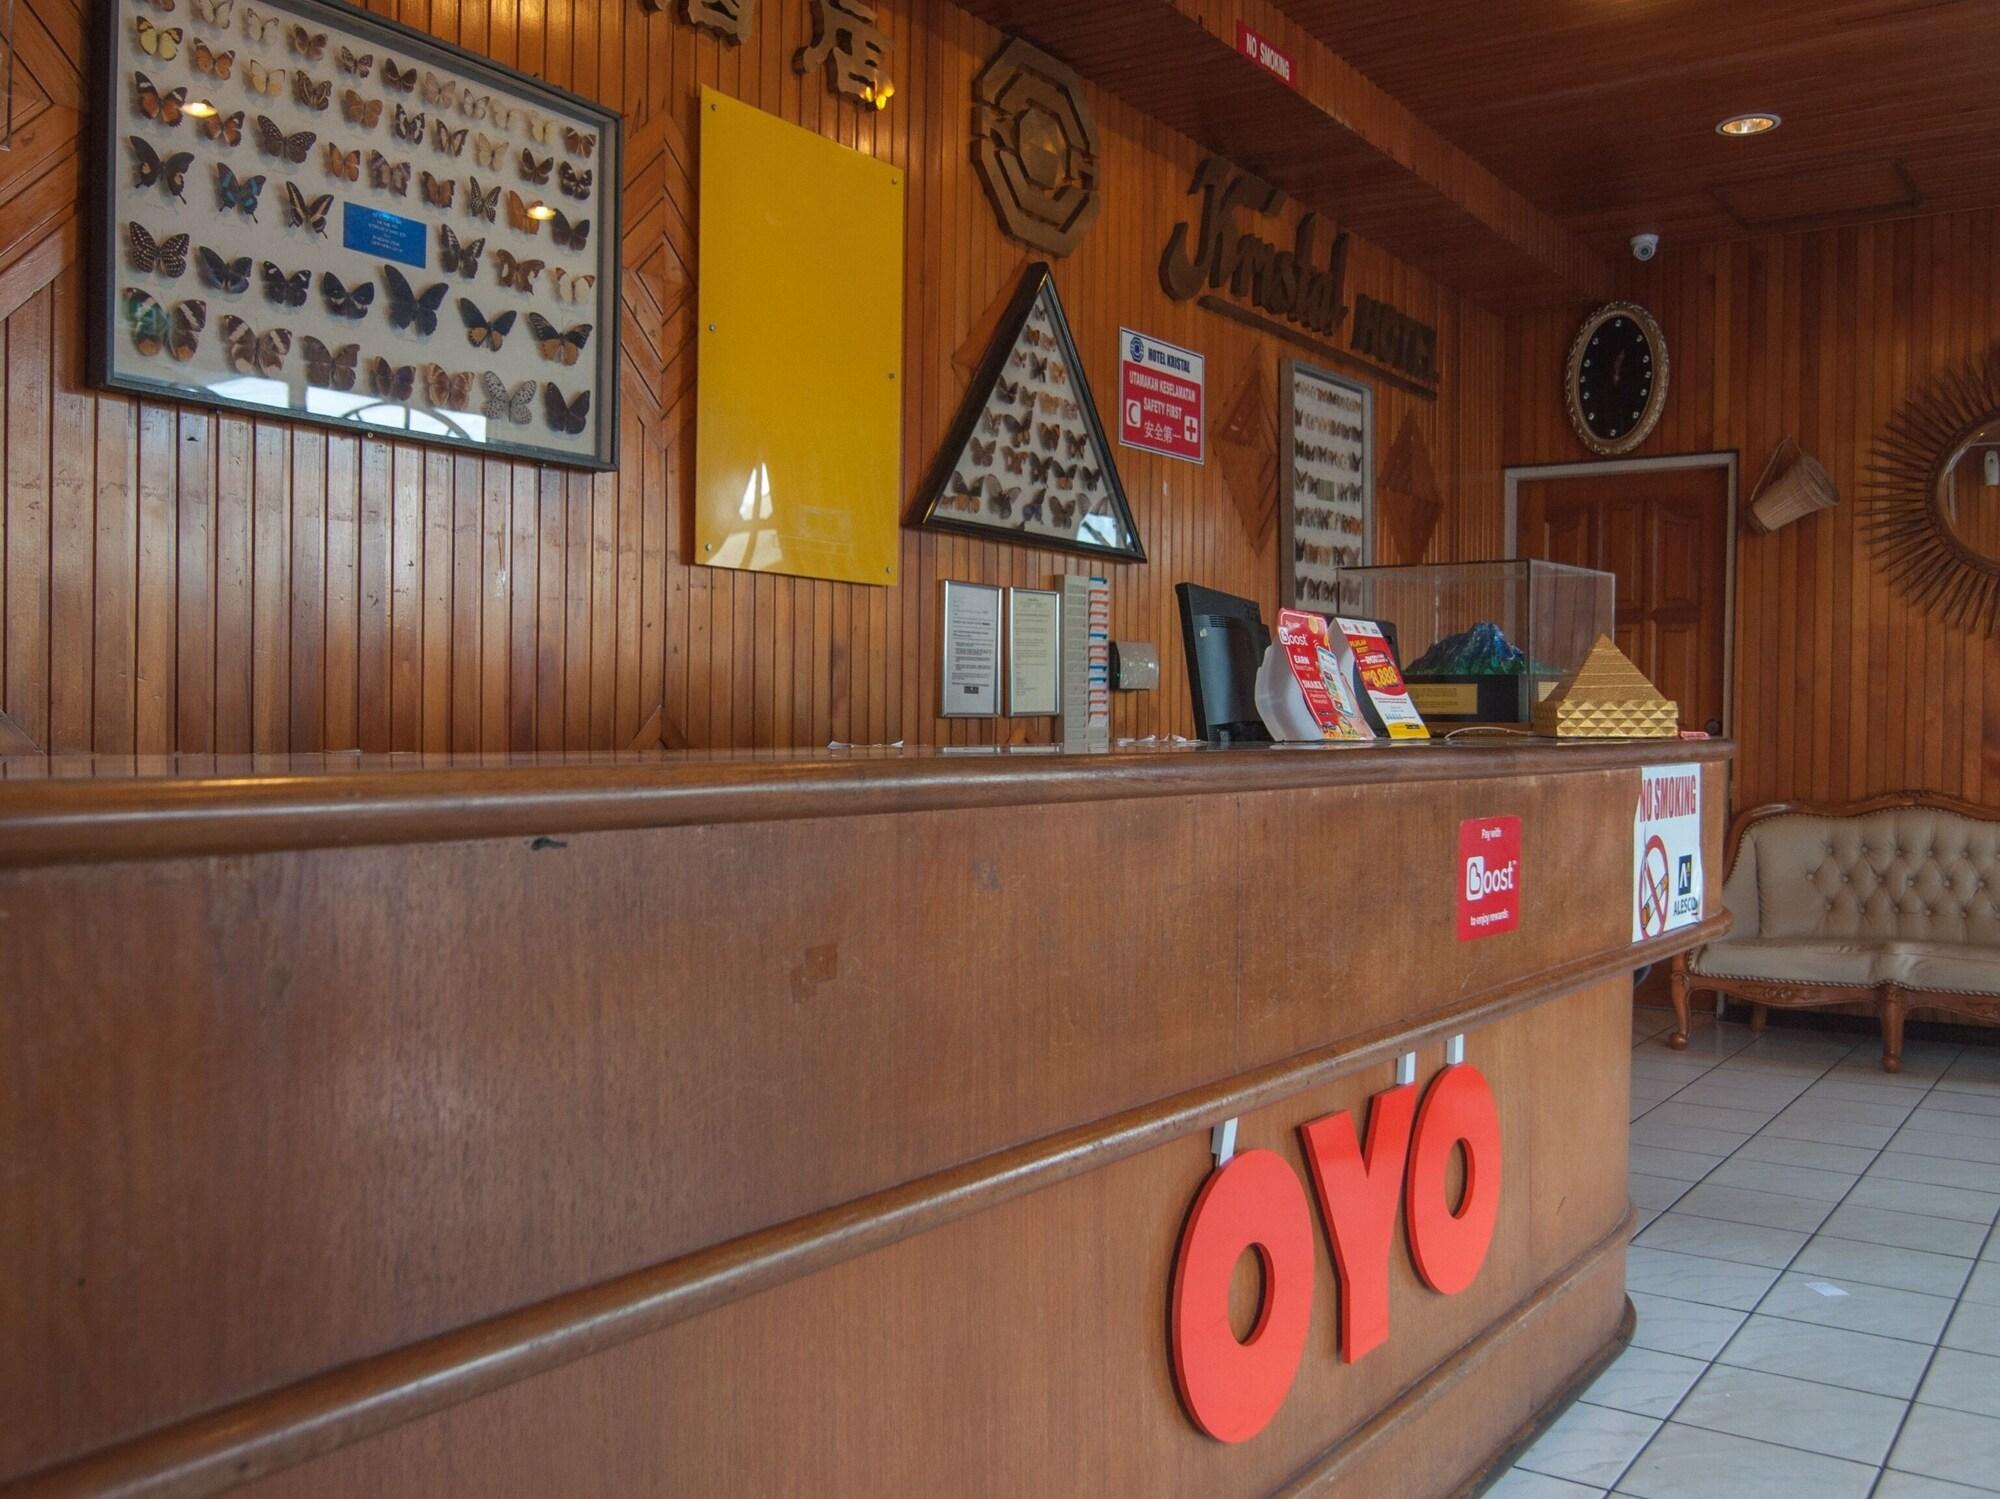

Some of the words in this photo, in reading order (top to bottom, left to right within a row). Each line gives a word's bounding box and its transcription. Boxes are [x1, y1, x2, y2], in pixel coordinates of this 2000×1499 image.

[1246, 32, 1257, 59] NO
[1260, 42, 1290, 81] SMOKING
[1148, 348, 1166, 366] HOTEL
[1168, 354, 1190, 374] KRISTAL
[1130, 371, 1159, 391] UTAMAKAN
[1160, 380, 1195, 401] KESELAMATAN
[1144, 397, 1166, 416] SAFETY
[1167, 404, 1182, 421] FIRST
[1144, 421, 1182, 443] 安全第一
[1640, 779, 1653, 823] NO
[1654, 775, 1697, 821] SMOKING
[1481, 828, 1490, 841] Pay
[1467, 856, 1514, 901] Boost
[1170, 1063, 1502, 1444] OYO
